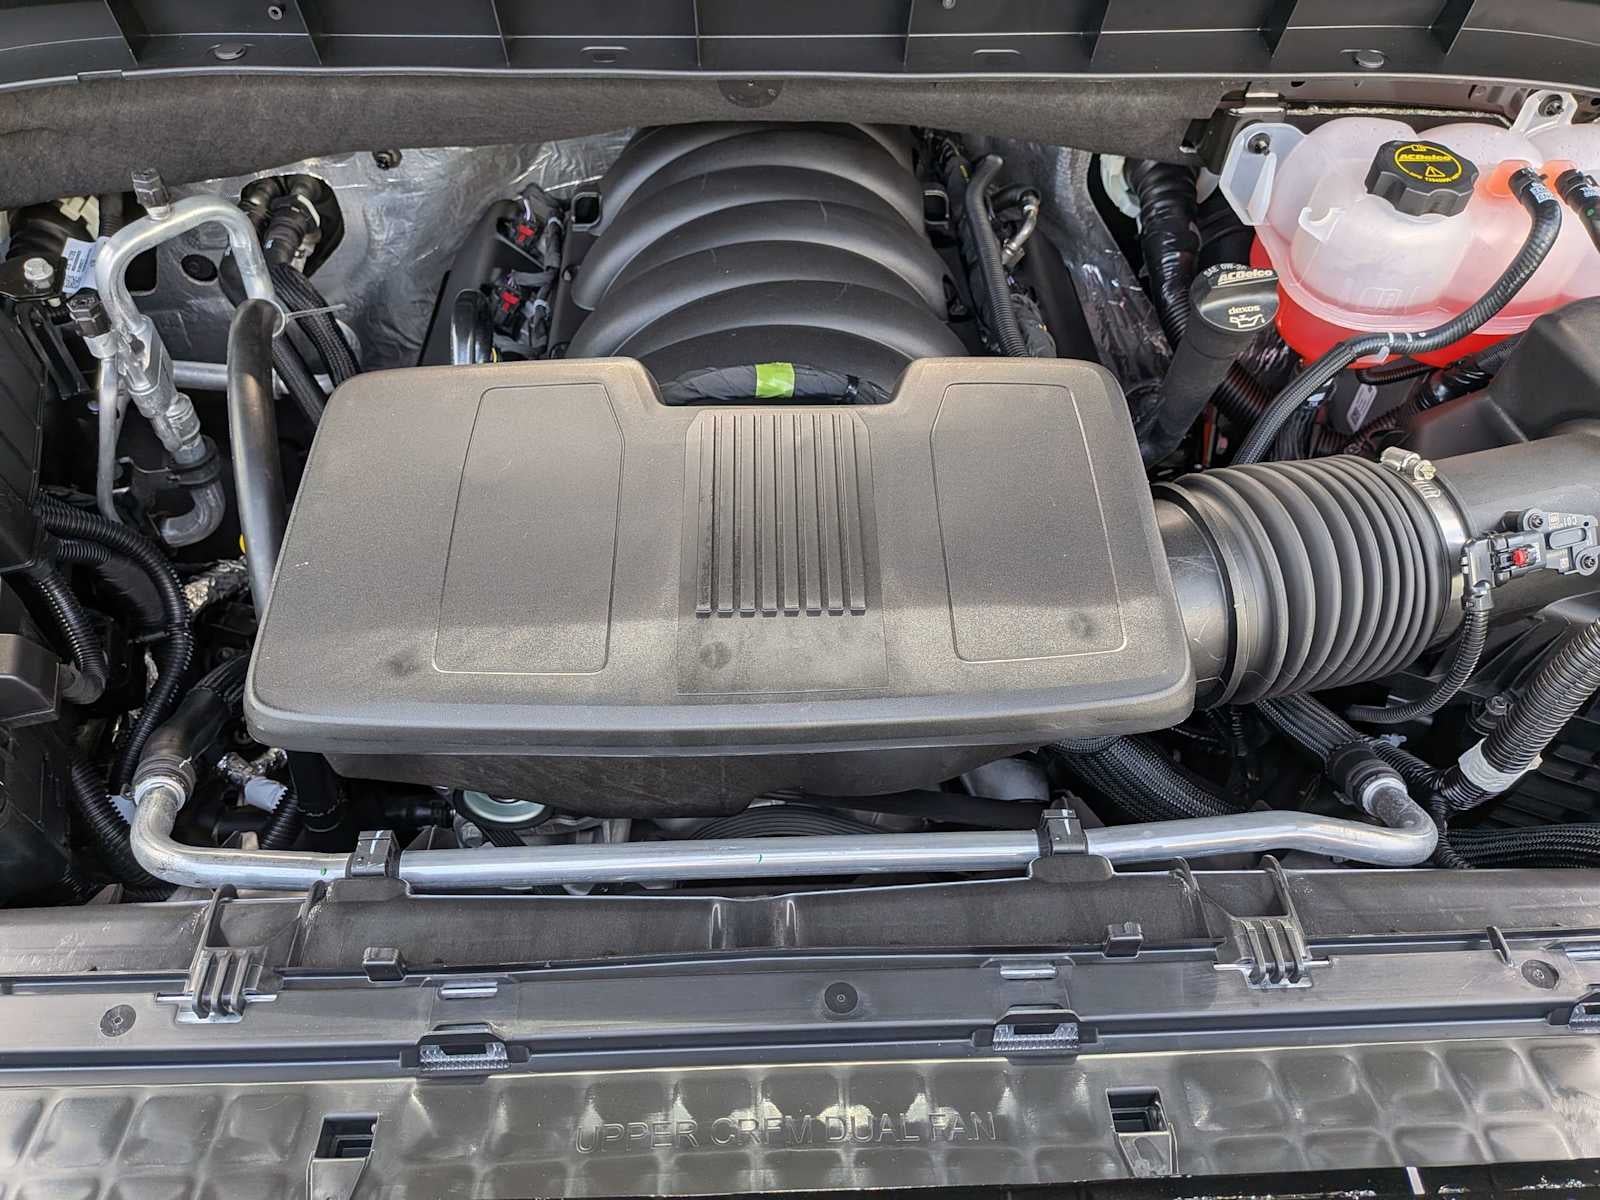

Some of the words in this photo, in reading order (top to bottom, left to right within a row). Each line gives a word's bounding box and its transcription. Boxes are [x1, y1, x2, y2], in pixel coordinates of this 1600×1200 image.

[1399, 153, 1452, 161] ACDelco
[1204, 266, 1219, 277] SAE
[1218, 270, 1273, 284] ACDelco
[1228, 305, 1260, 315] dexos
[574, 1120, 699, 1155] UPPER
[710, 1114, 813, 1147] CRFM
[826, 1112, 920, 1144] DUAL
[927, 1111, 997, 1142] FAN
